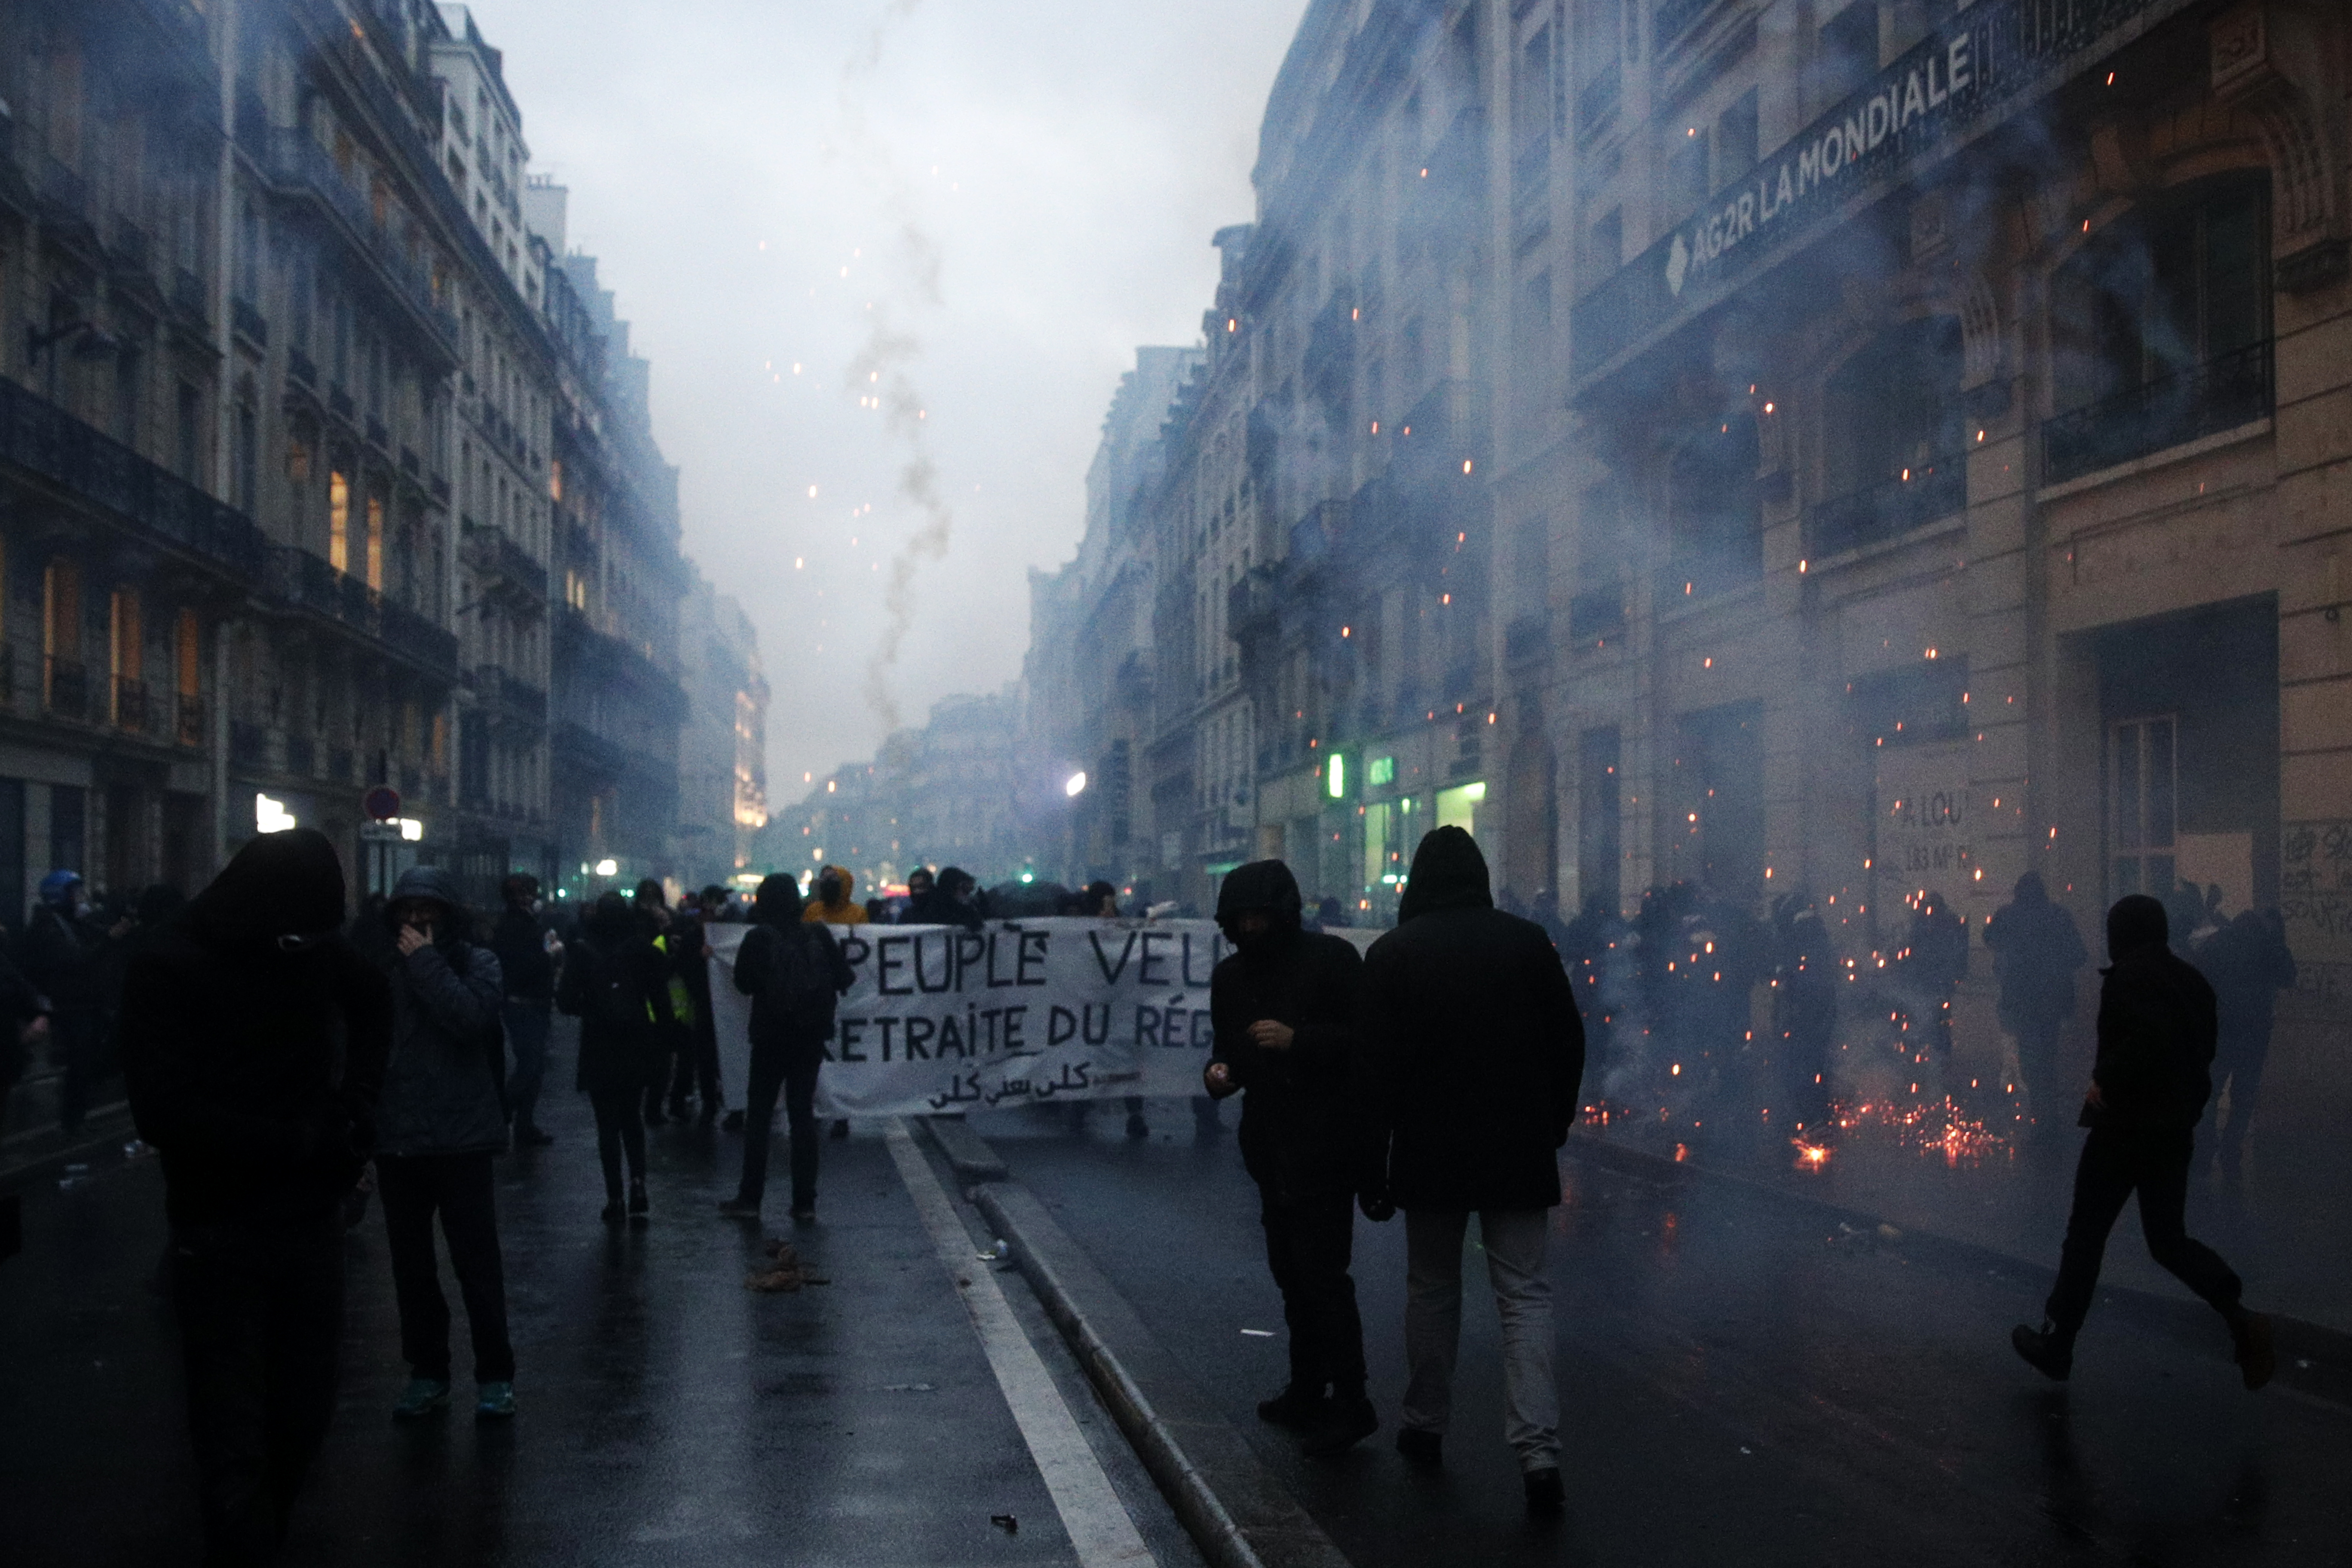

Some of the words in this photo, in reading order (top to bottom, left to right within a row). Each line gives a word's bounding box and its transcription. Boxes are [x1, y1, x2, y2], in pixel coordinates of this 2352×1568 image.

[1691, 192, 1754, 273] AG2R
[1760, 165, 1793, 224] LA
[1798, 32, 1970, 196] MONDIALE
[840, 930, 1050, 996] PEUPLE
[1088, 929, 1222, 987] VEU
[1047, 1003, 1110, 1046] DU
[1135, 992, 1215, 1048] RÉG
